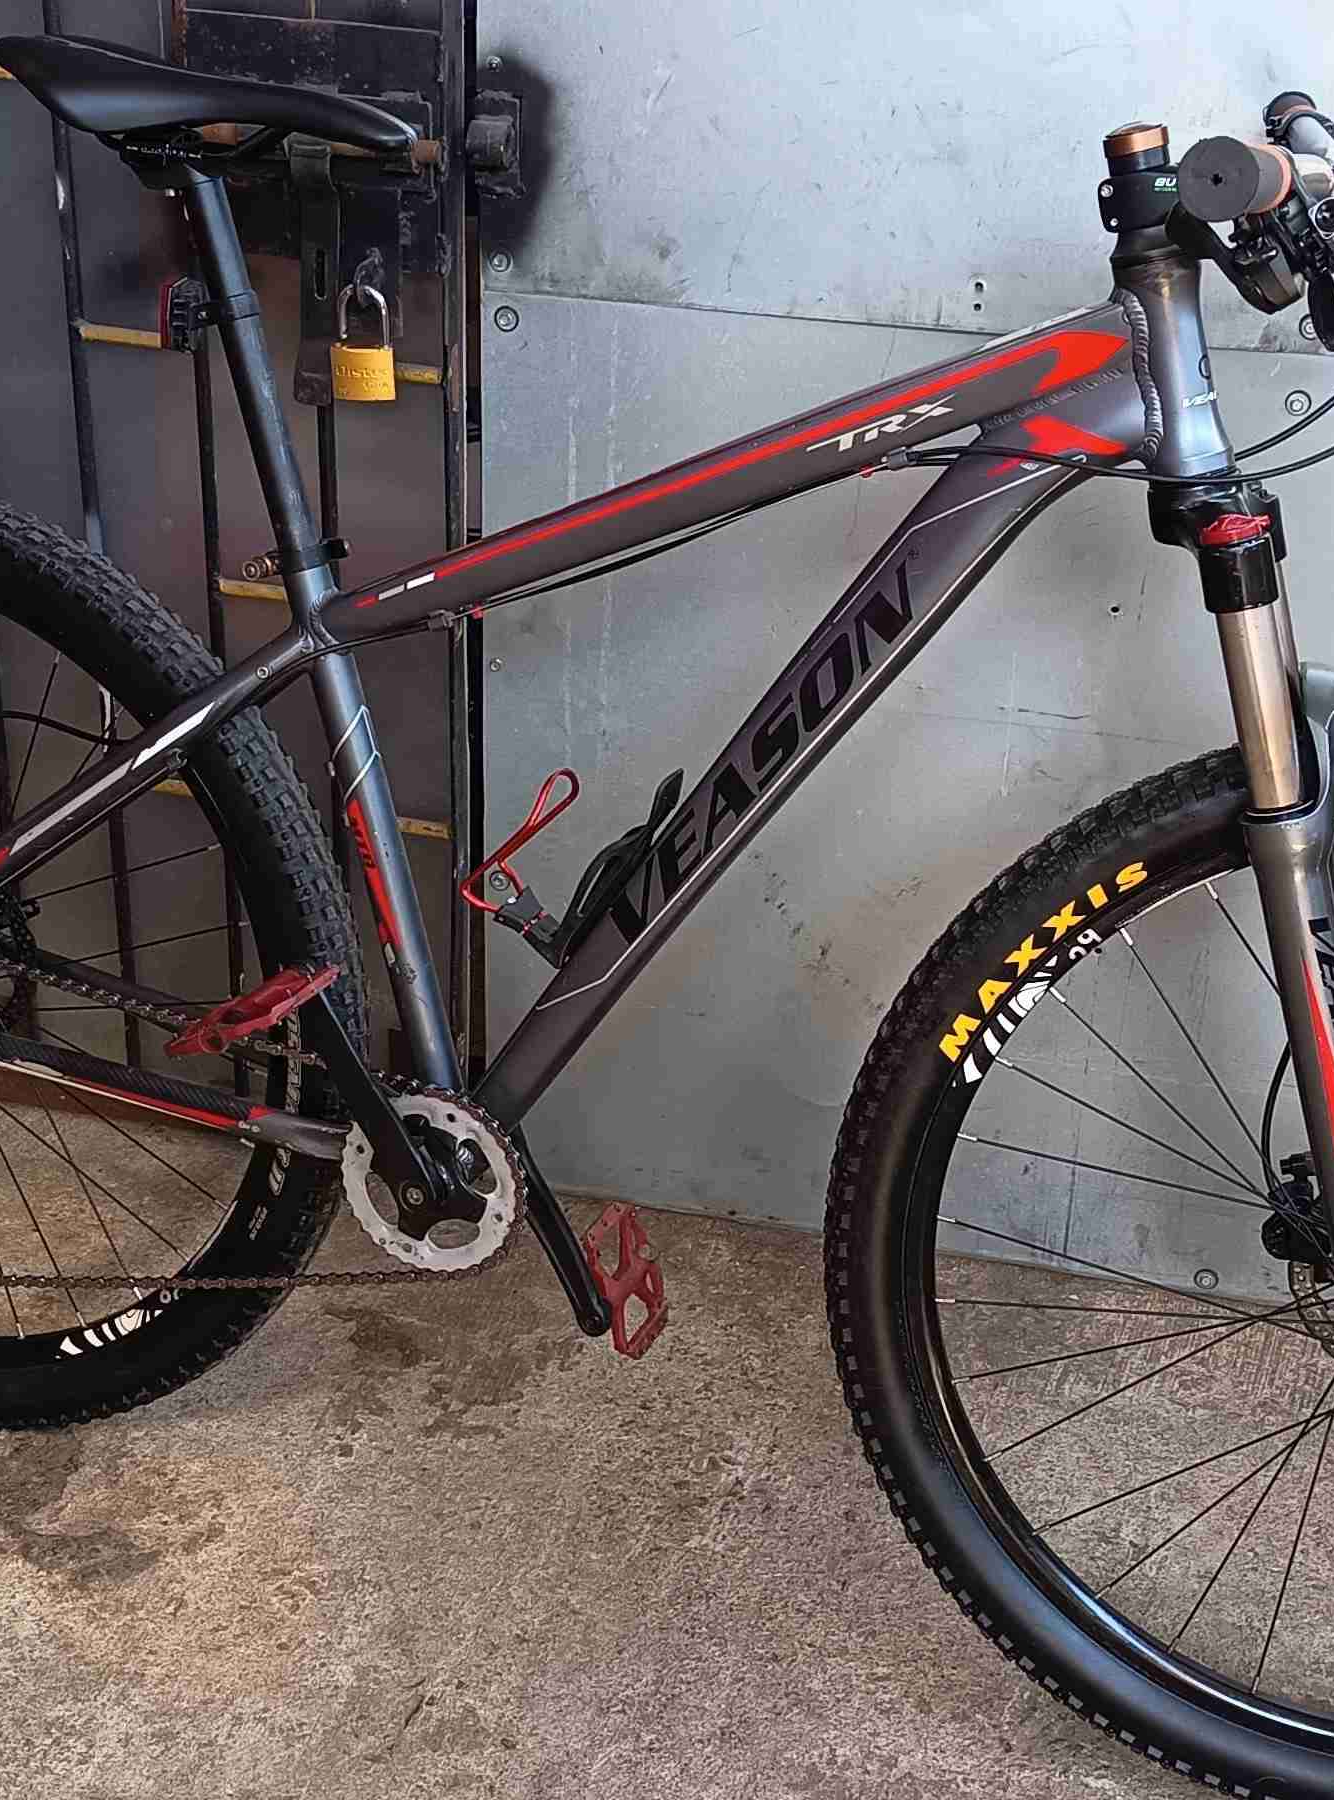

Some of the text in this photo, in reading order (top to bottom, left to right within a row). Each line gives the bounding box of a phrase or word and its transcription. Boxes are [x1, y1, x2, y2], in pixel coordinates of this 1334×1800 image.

[806, 393, 955, 452] TRX
[609, 557, 914, 946] VEASON
[938, 861, 1148, 1063] MAXXIS
